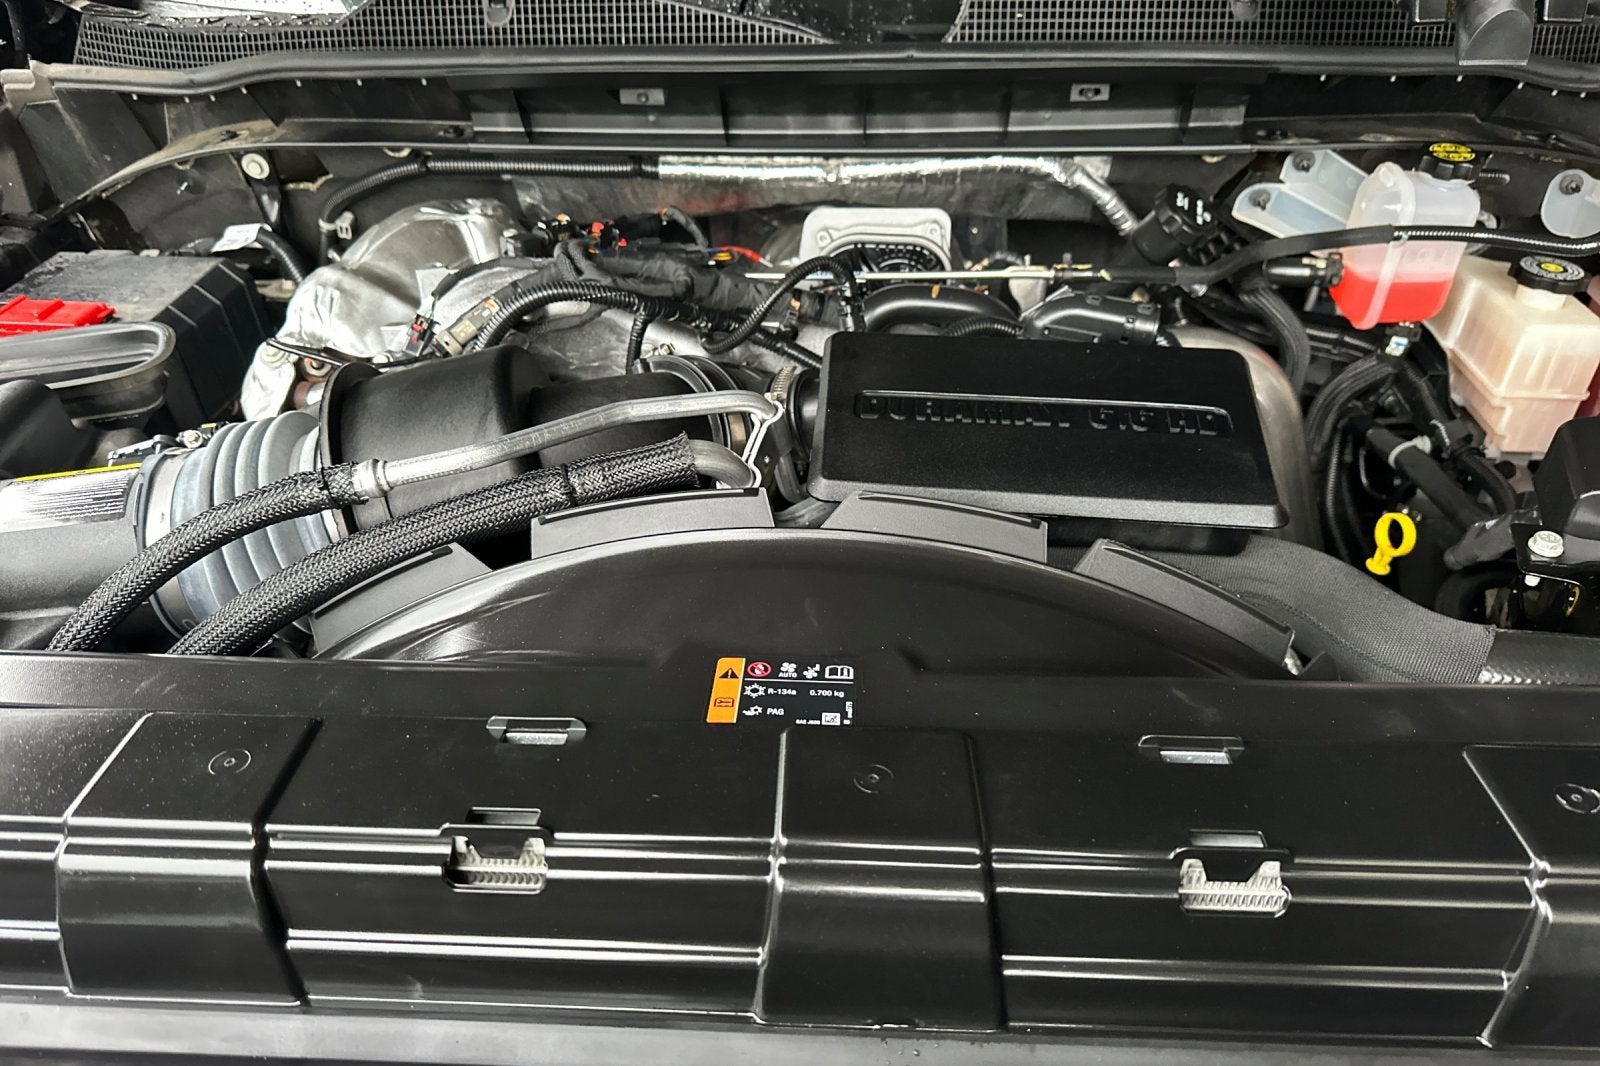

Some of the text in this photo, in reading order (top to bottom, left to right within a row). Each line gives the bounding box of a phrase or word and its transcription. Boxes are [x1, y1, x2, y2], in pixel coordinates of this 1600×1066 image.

[858, 396, 1221, 436] DURAMAX 6.6 HD
[834, 690, 845, 698] kg
[767, 708, 784, 716] PAG
